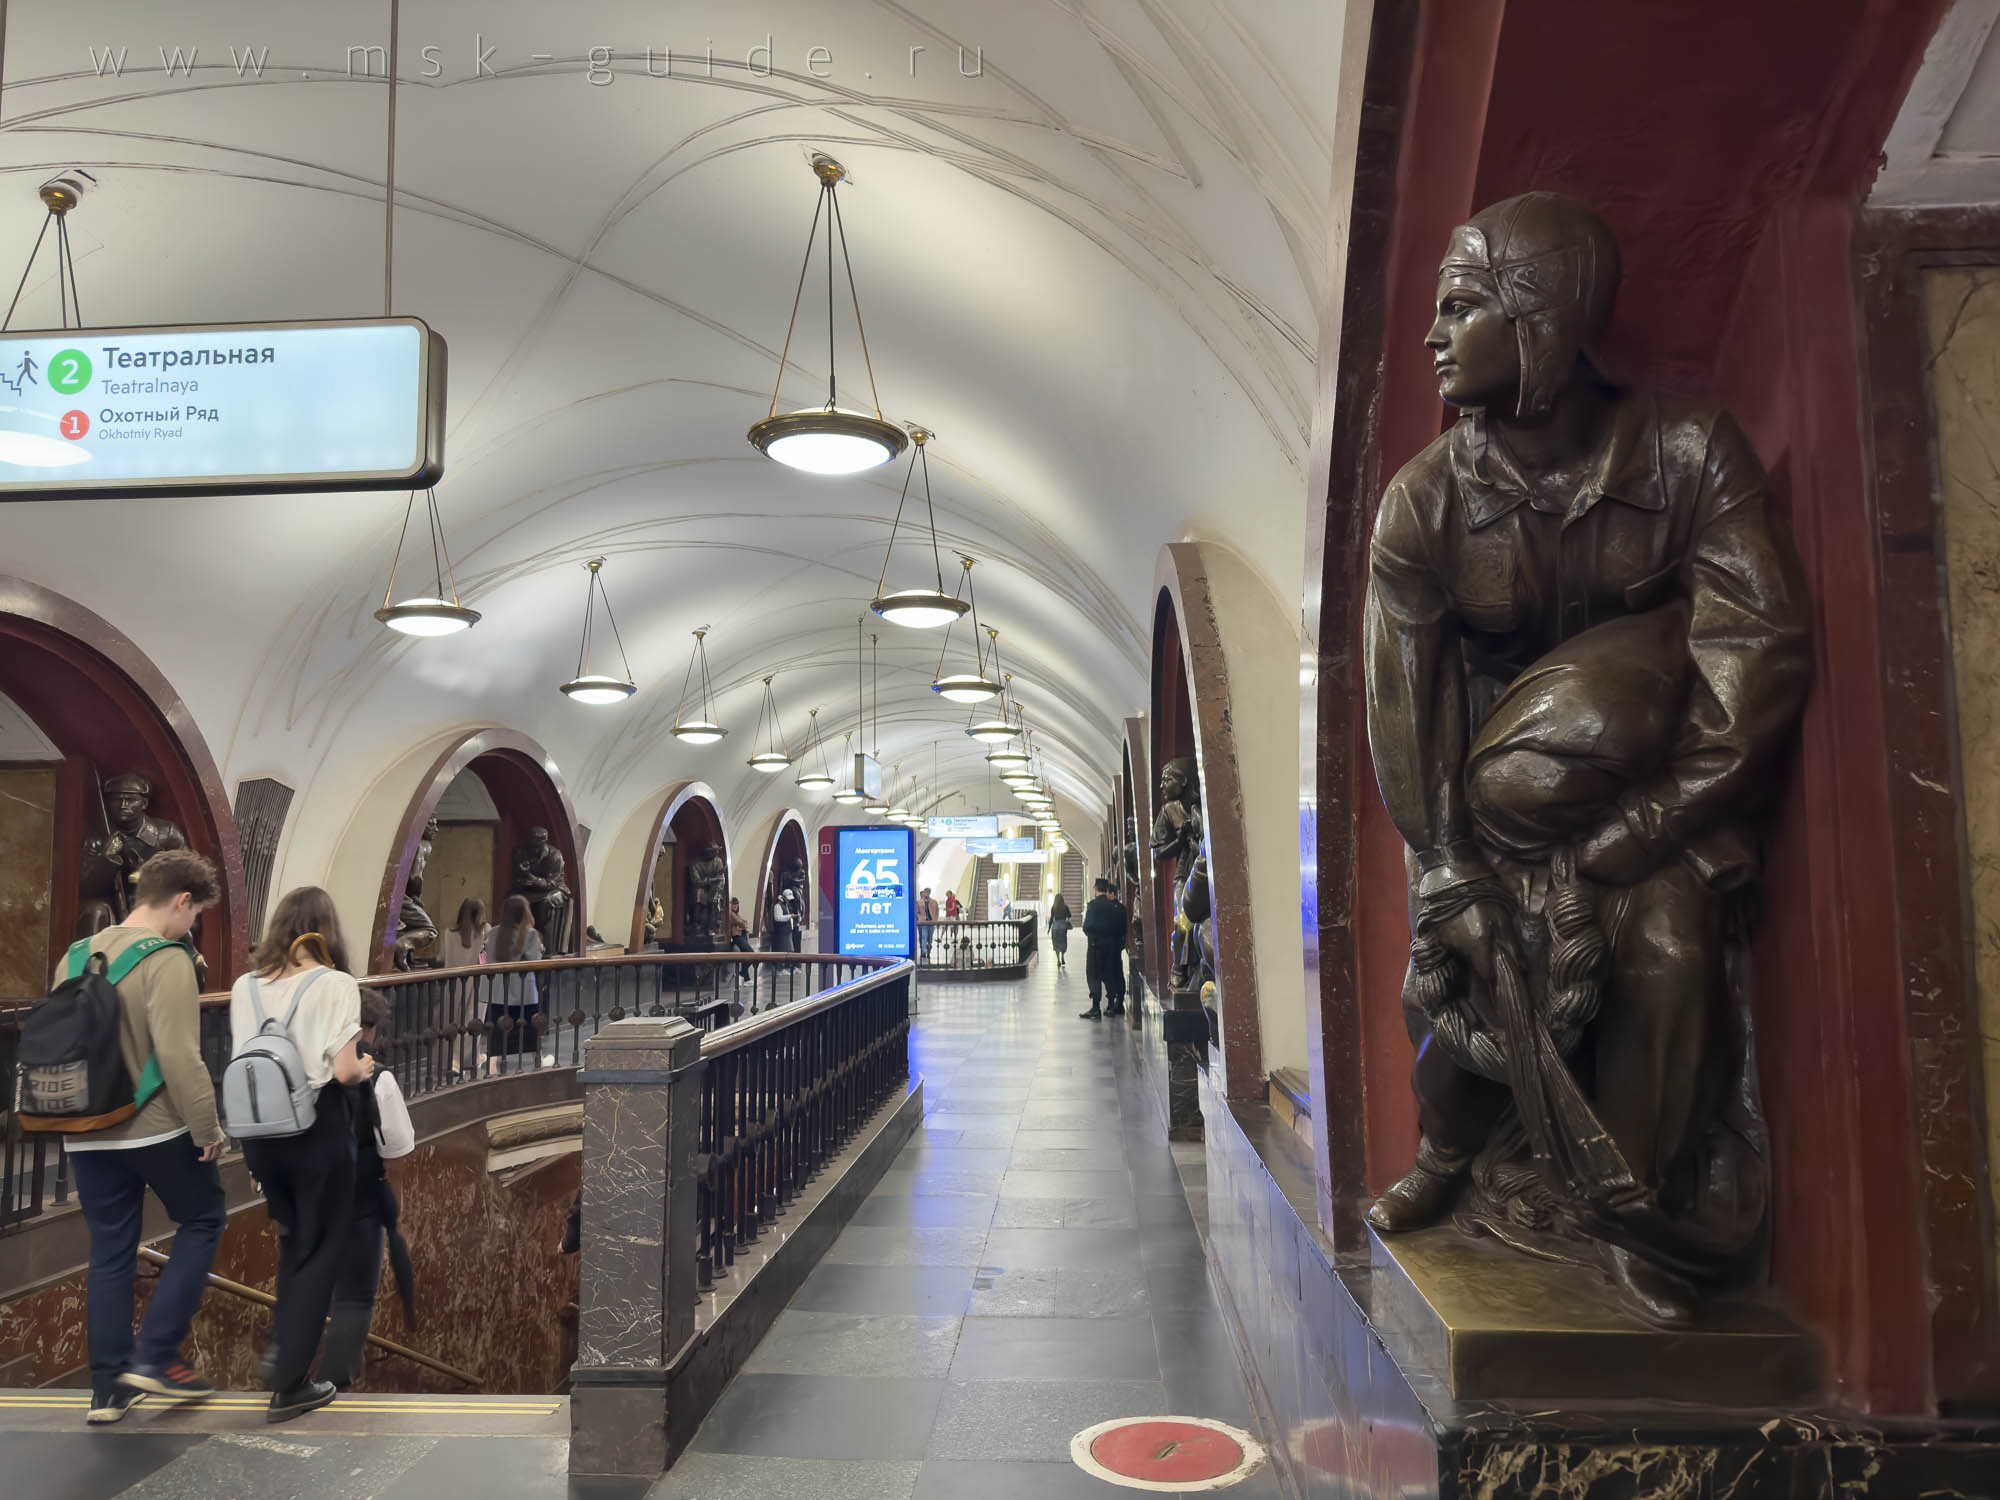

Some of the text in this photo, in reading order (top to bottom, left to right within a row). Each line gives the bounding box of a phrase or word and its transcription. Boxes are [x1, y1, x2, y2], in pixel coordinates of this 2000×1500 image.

[61, 346, 276, 385] 2 Театральная
[101, 377, 199, 396] Teatralnaya
[69, 406, 220, 434] 1 Охотный Ряд
[98, 426, 184, 441] Okhotniy Ryad
[849, 858, 900, 886] 65
[859, 902, 892, 915] лет
